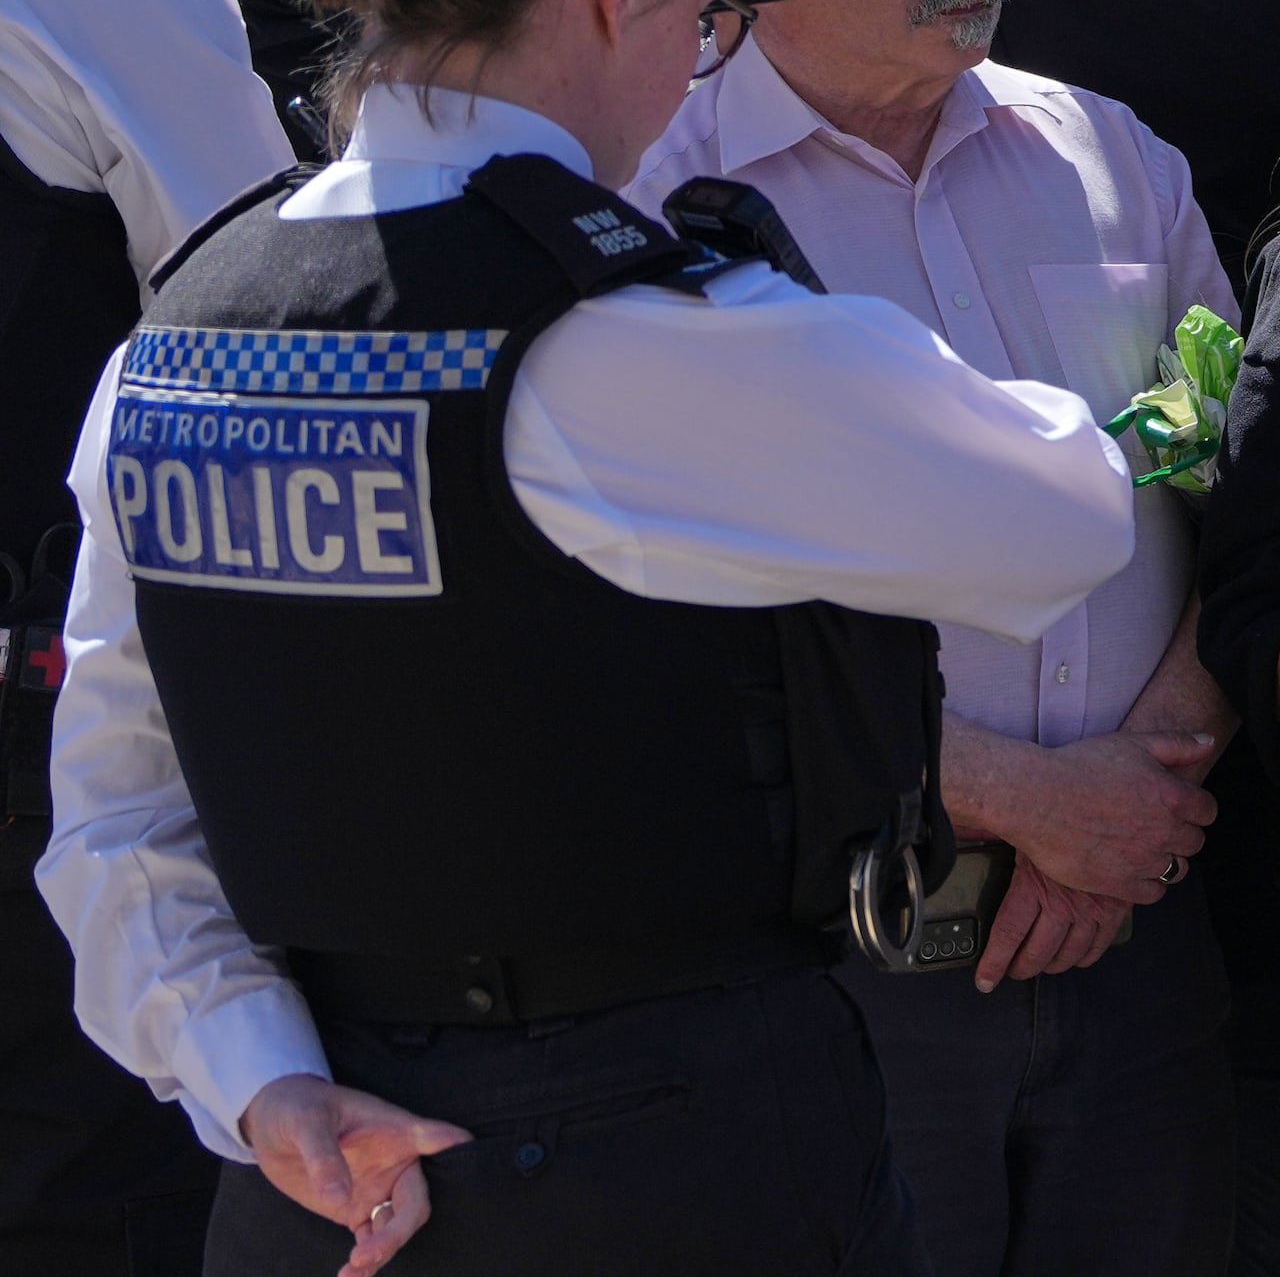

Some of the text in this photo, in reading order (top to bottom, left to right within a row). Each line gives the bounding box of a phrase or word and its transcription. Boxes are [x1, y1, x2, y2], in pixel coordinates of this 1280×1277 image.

[590, 225, 647, 257] 1855
[117, 410, 402, 457] METROPOLITAN
[112, 454, 415, 574] POLICE
